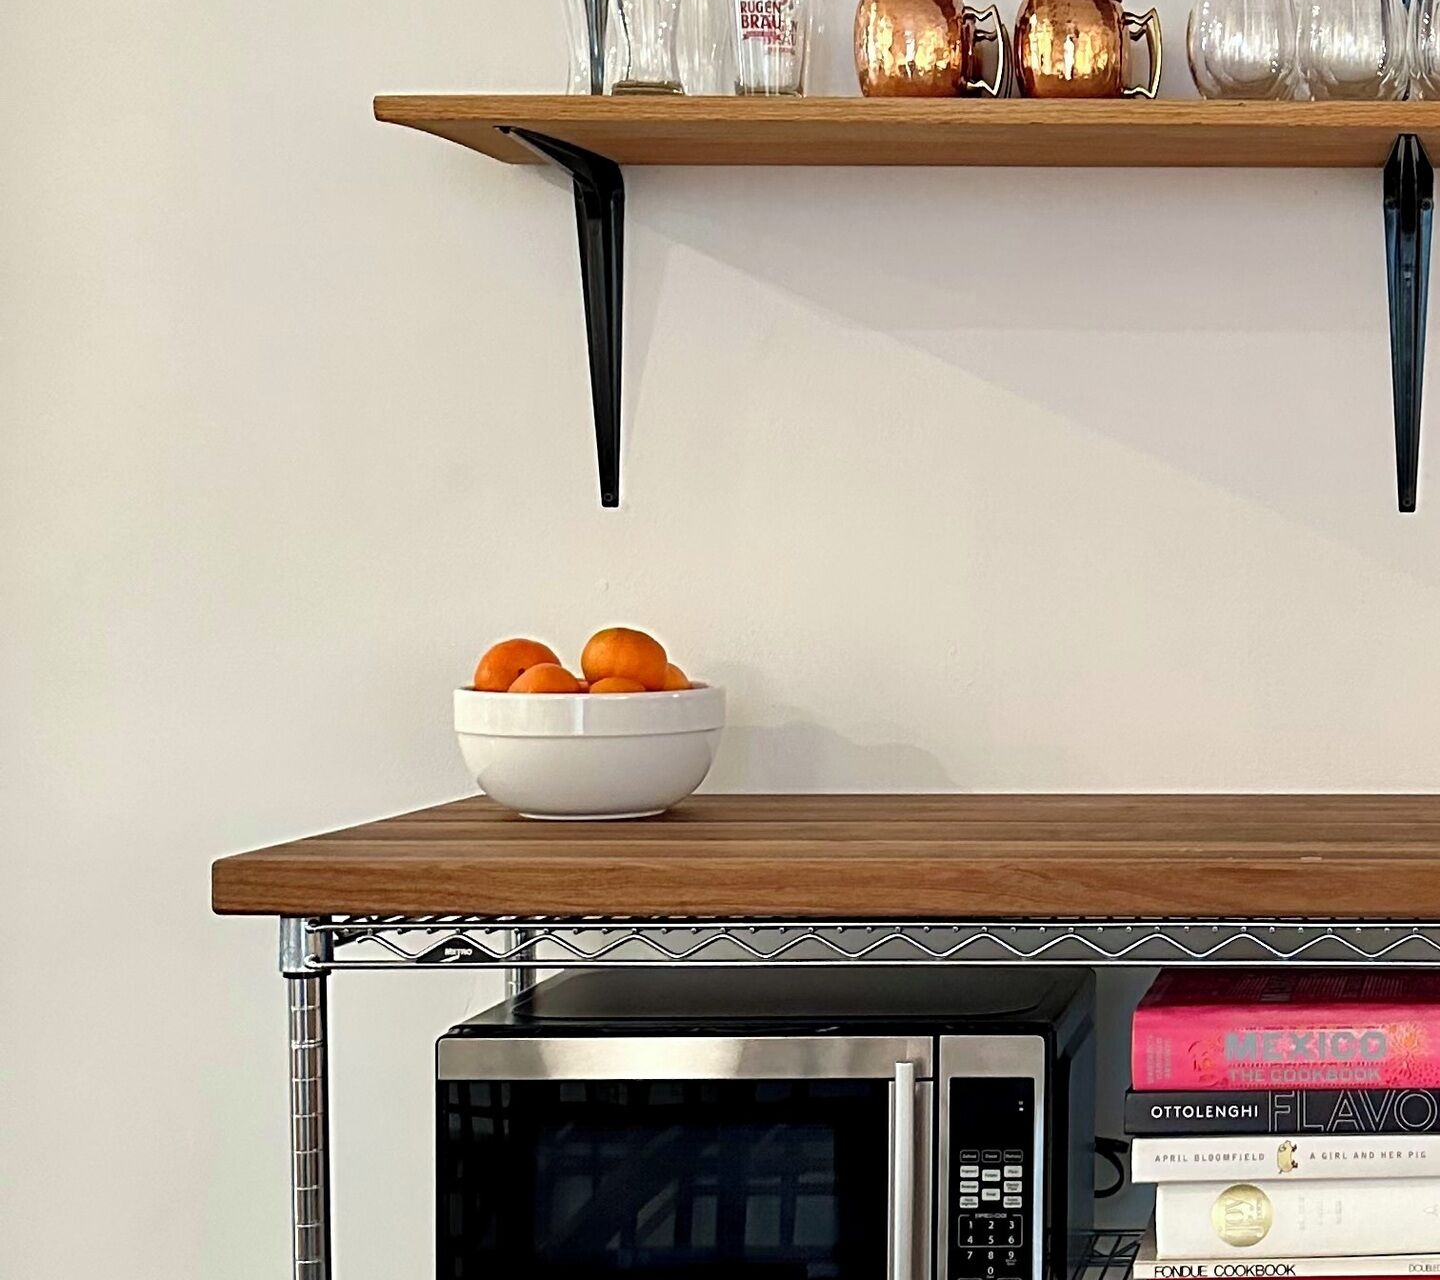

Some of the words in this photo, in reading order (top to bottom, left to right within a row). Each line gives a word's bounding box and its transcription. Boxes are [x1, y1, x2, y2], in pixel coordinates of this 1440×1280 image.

[1224, 1029, 1388, 1062] MEXICO
[1228, 1068, 1264, 1083] THE
[1269, 1067, 1382, 1083] COOKBOOK
[1150, 1104, 1259, 1119] OTTOLENGHI
[1154, 1154, 1189, 1163] APRIL
[1194, 1153, 1265, 1163] BLOOMFIELD
[1309, 1152, 1316, 1160] A
[1321, 1151, 1348, 1160] GIRL
[1353, 1151, 1376, 1160] AND
[1381, 1151, 1403, 1160] HER
[1408, 1151, 1427, 1160] PIG
[968, 1220, 973, 1230] 1
[988, 1220, 995, 1230] 2
[1008, 1220, 1015, 1230] 3
[967, 1235, 974, 1245] 4
[988, 1235, 995, 1245] 5
[1008, 1235, 1015, 1245] 6
[967, 1251, 973, 1260] 7
[987, 1251, 994, 1260] 8
[1008, 1251, 1015, 1260] 9
[987, 1266, 994, 1275] 0
[1154, 1264, 1208, 1279] FONDUE
[1213, 1263, 1297, 1278] COOKBOOK
